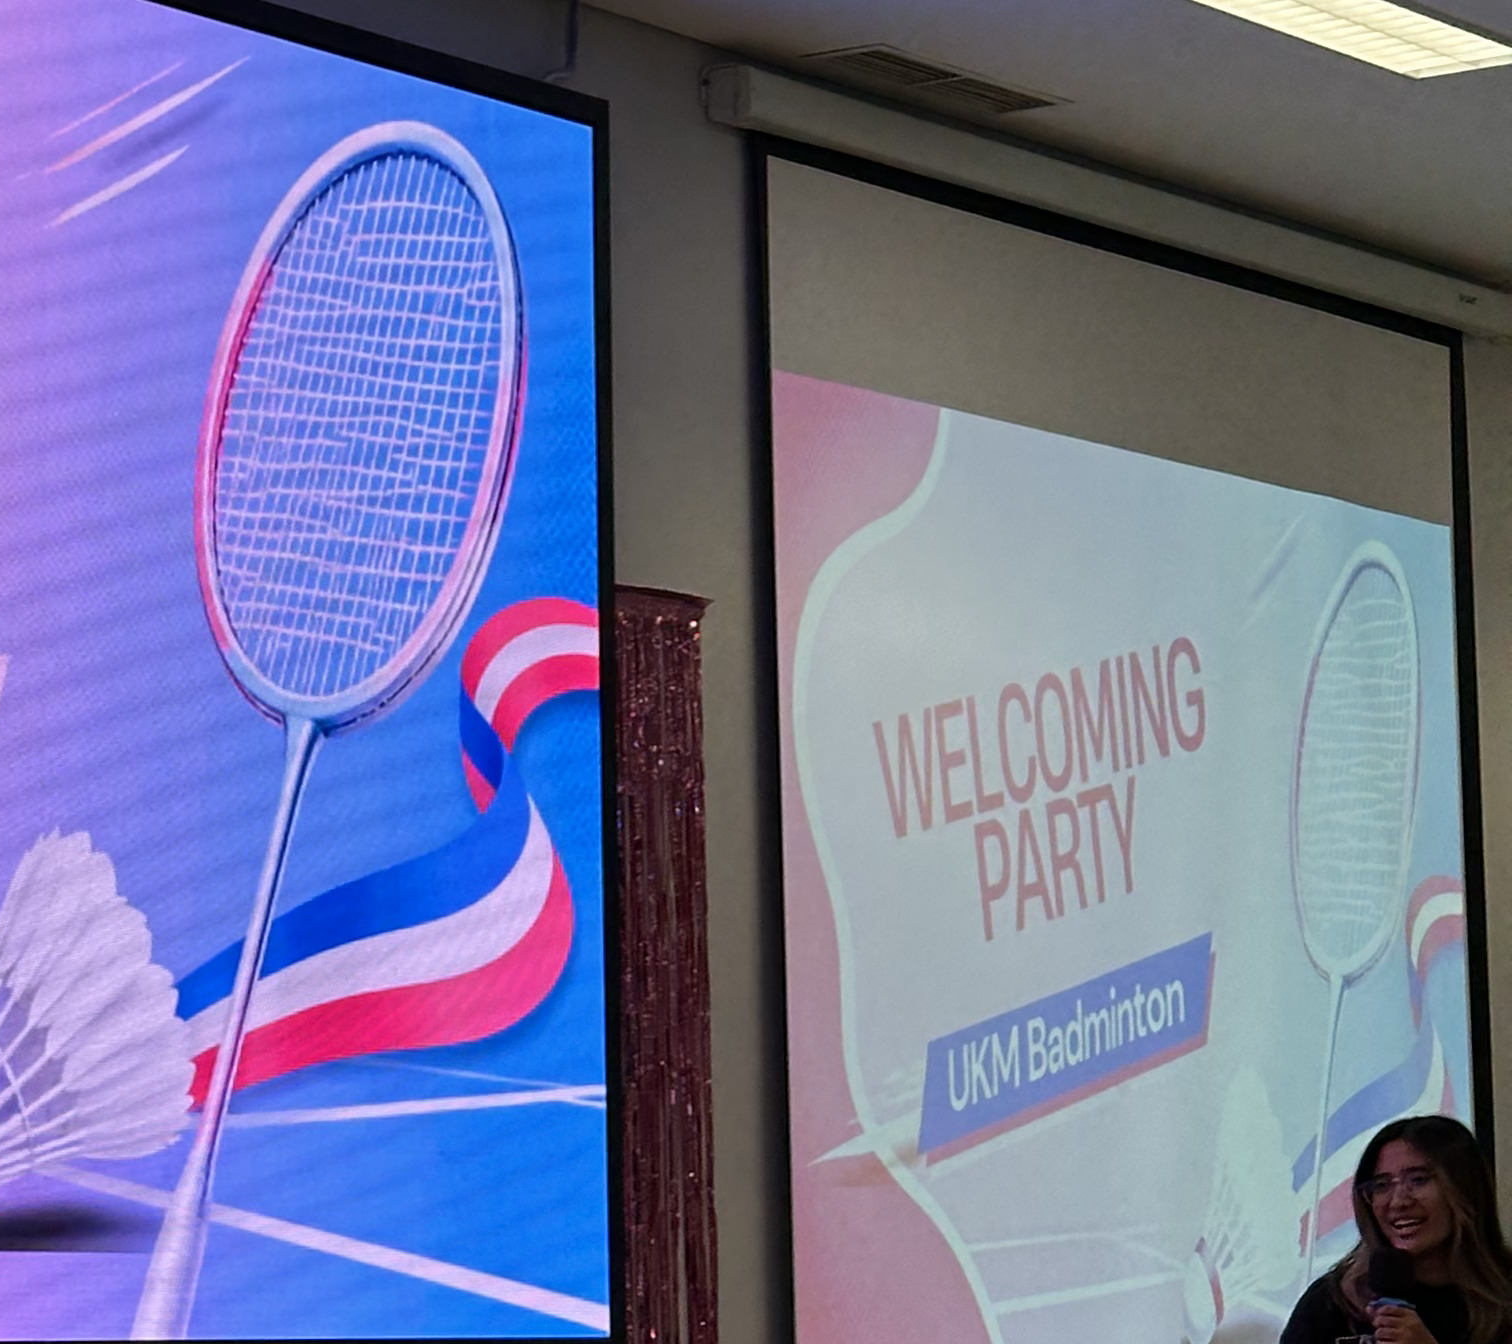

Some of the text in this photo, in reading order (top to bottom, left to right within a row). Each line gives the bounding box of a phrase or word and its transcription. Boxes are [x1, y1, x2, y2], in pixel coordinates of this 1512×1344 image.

[872, 637, 1206, 839] WELCOMING
[974, 775, 1136, 942] PARTY
[948, 979, 1185, 1111] UKM Badminton
